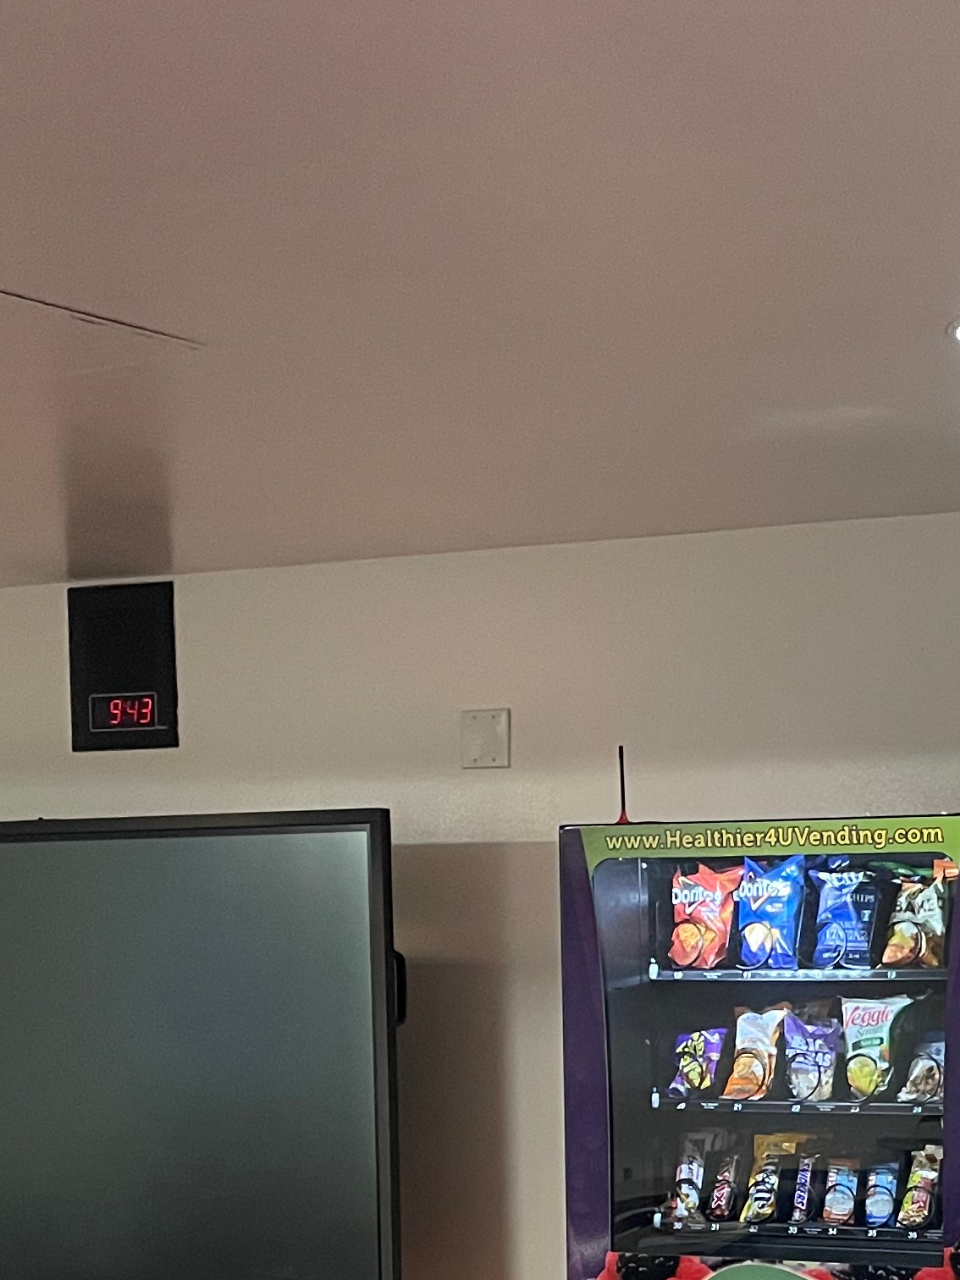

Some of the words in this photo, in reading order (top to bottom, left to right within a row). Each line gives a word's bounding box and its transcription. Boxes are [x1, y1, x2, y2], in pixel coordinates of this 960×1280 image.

[605, 825, 944, 849] www.Healthier4UVending.com
[738, 878, 791, 899] Doritos
[843, 1005, 895, 1029] Veggie
[794, 1162, 813, 1210] SNICKERS
